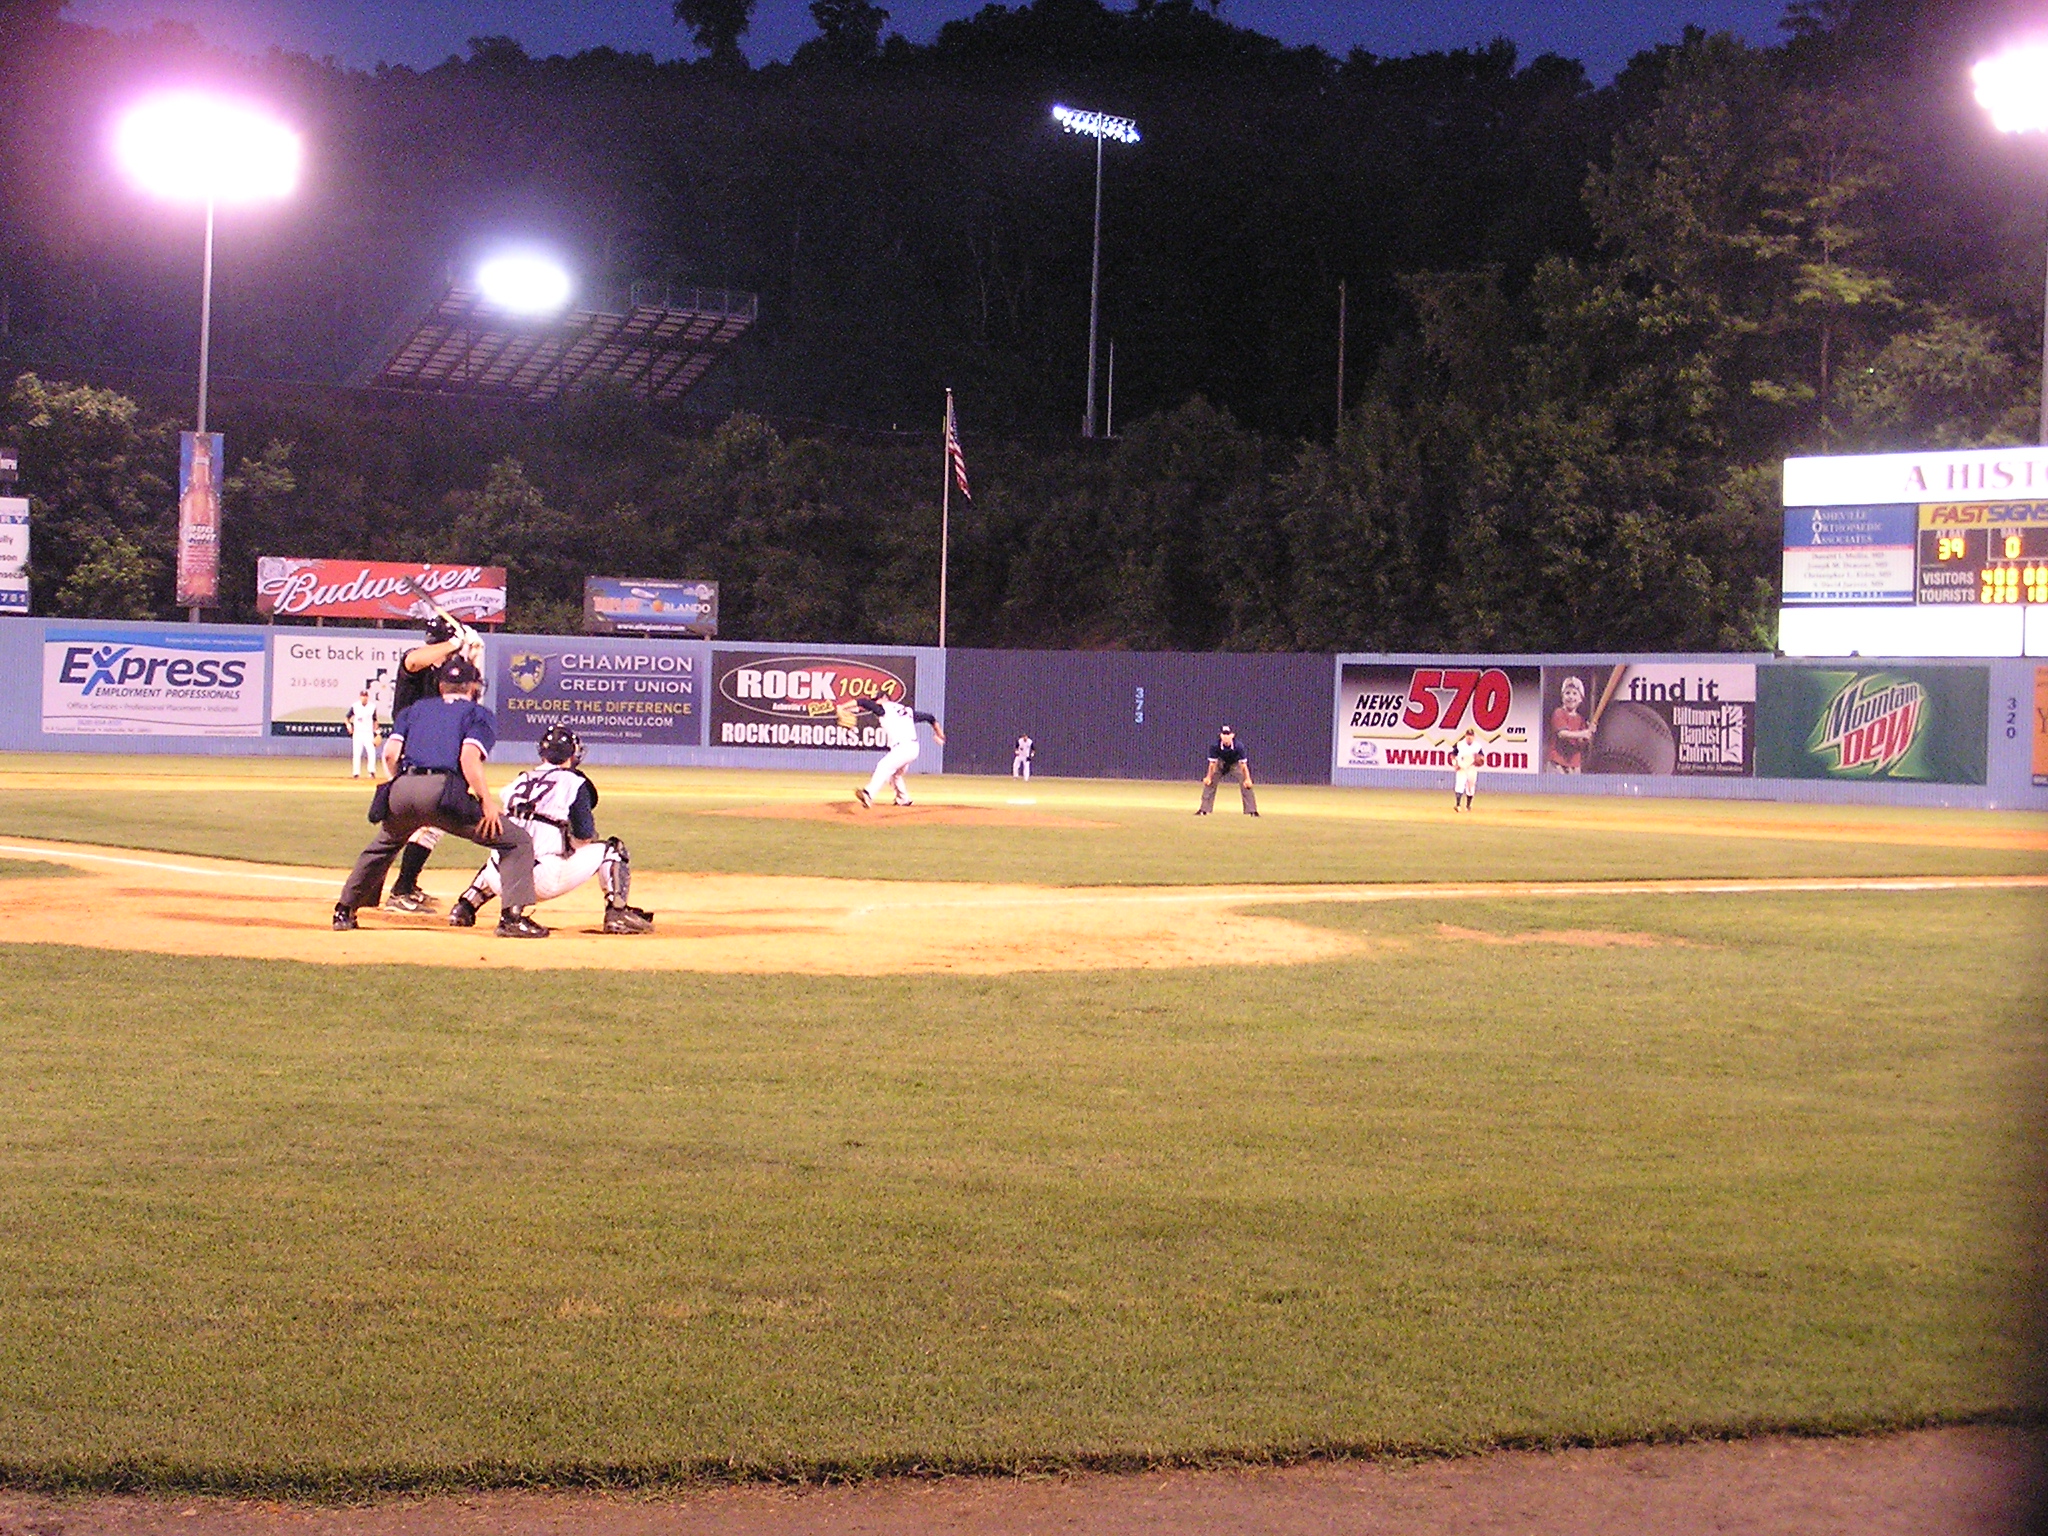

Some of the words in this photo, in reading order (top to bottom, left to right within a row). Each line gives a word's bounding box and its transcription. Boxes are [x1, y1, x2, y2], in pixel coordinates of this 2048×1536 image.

[1904, 465, 1928, 491] A
[1947, 461, 2048, 490] HIST
[1811, 509, 1866, 521] ASHEVILLE
[1811, 521, 1882, 533] ORTHOPAEDIC
[1811, 533, 1873, 545] ASSOCIATES
[2004, 535, 2021, 559] 0
[1938, 537, 1966, 561] 39
[1922, 571, 1974, 586] VISITORS
[264, 564, 481, 614] Budweiser
[1920, 588, 1975, 602] TOURISTS
[474, 593, 501, 605] Lager
[290, 643, 321, 660] Get
[327, 645, 364, 661] back
[371, 647, 385, 662] in
[59, 646, 247, 696] Express
[560, 653, 693, 672] CHAMPION
[290, 677, 339, 688] 213-0850
[560, 678, 627, 692] CREDIT
[634, 680, 693, 694] UNION
[737, 669, 836, 700] ROCK
[1628, 677, 1686, 701] find
[1697, 677, 1719, 701] it
[95, 687, 161, 698] EMPLOYMENT
[165, 688, 240, 700] PROFESSIONALS
[1355, 694, 1404, 711] NEWS
[1402, 668, 1512, 732] 570
[507, 698, 571, 712] EXPLORE
[575, 700, 602, 713] THE
[606, 701, 692, 715] DIFFERENCE
[1134, 687, 1144, 724] 373
[1828, 681, 1920, 742] Mountain
[526, 713, 674, 727] WWW.CHAMPIONCU.COM
[1350, 711, 1399, 727] RADIO
[1673, 705, 1721, 726] Biltmore
[2006, 697, 2017, 739] 320
[284, 725, 342, 733] TREATMENT
[1506, 726, 1526, 735] am
[1680, 724, 1720, 746] Baptist
[1385, 748, 1528, 769] wwnom
[1678, 743, 1720, 764] Church
[508, 780, 557, 810] 27
